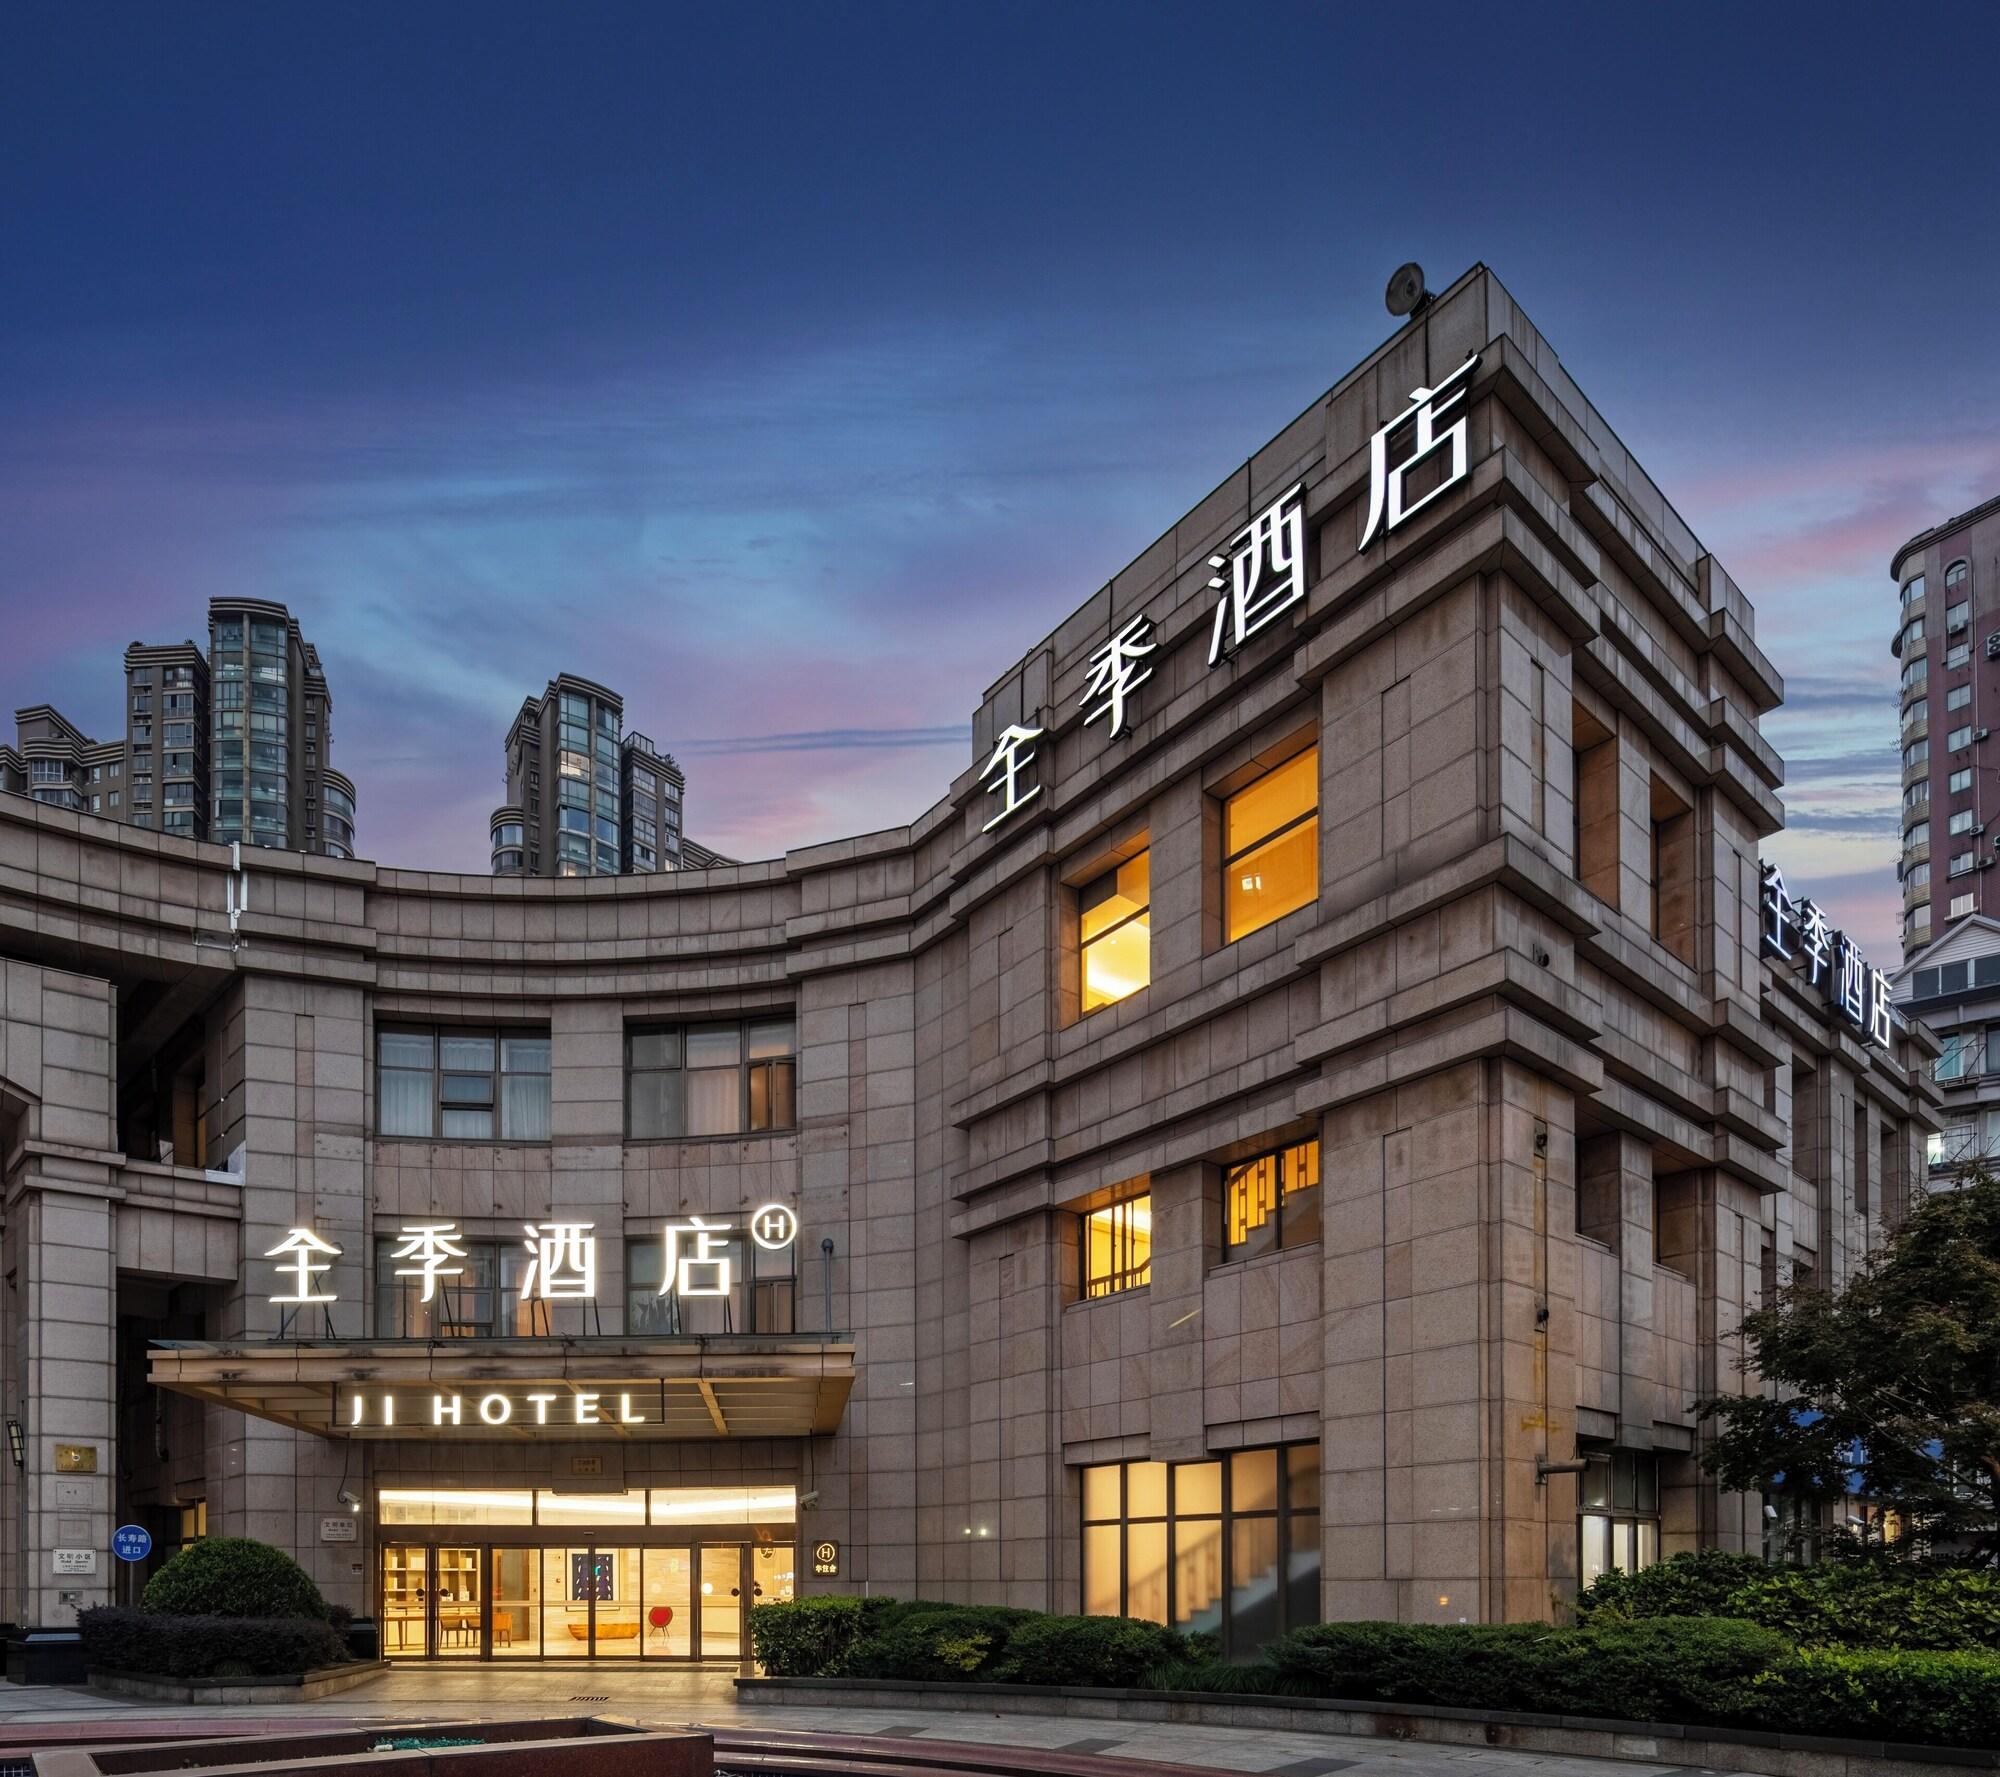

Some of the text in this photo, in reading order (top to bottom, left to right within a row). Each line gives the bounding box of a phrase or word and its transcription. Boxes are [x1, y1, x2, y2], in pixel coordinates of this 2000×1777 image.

[979, 354, 1481, 833] 全季酒店
[1764, 864, 1893, 1049] 全季酒店
[264, 1215, 732, 1303] 全季酒店
[351, 1393, 646, 1425] JI HOTEL
[118, 1533, 147, 1544] 长寿路
[122, 1545, 141, 1554] 进口
